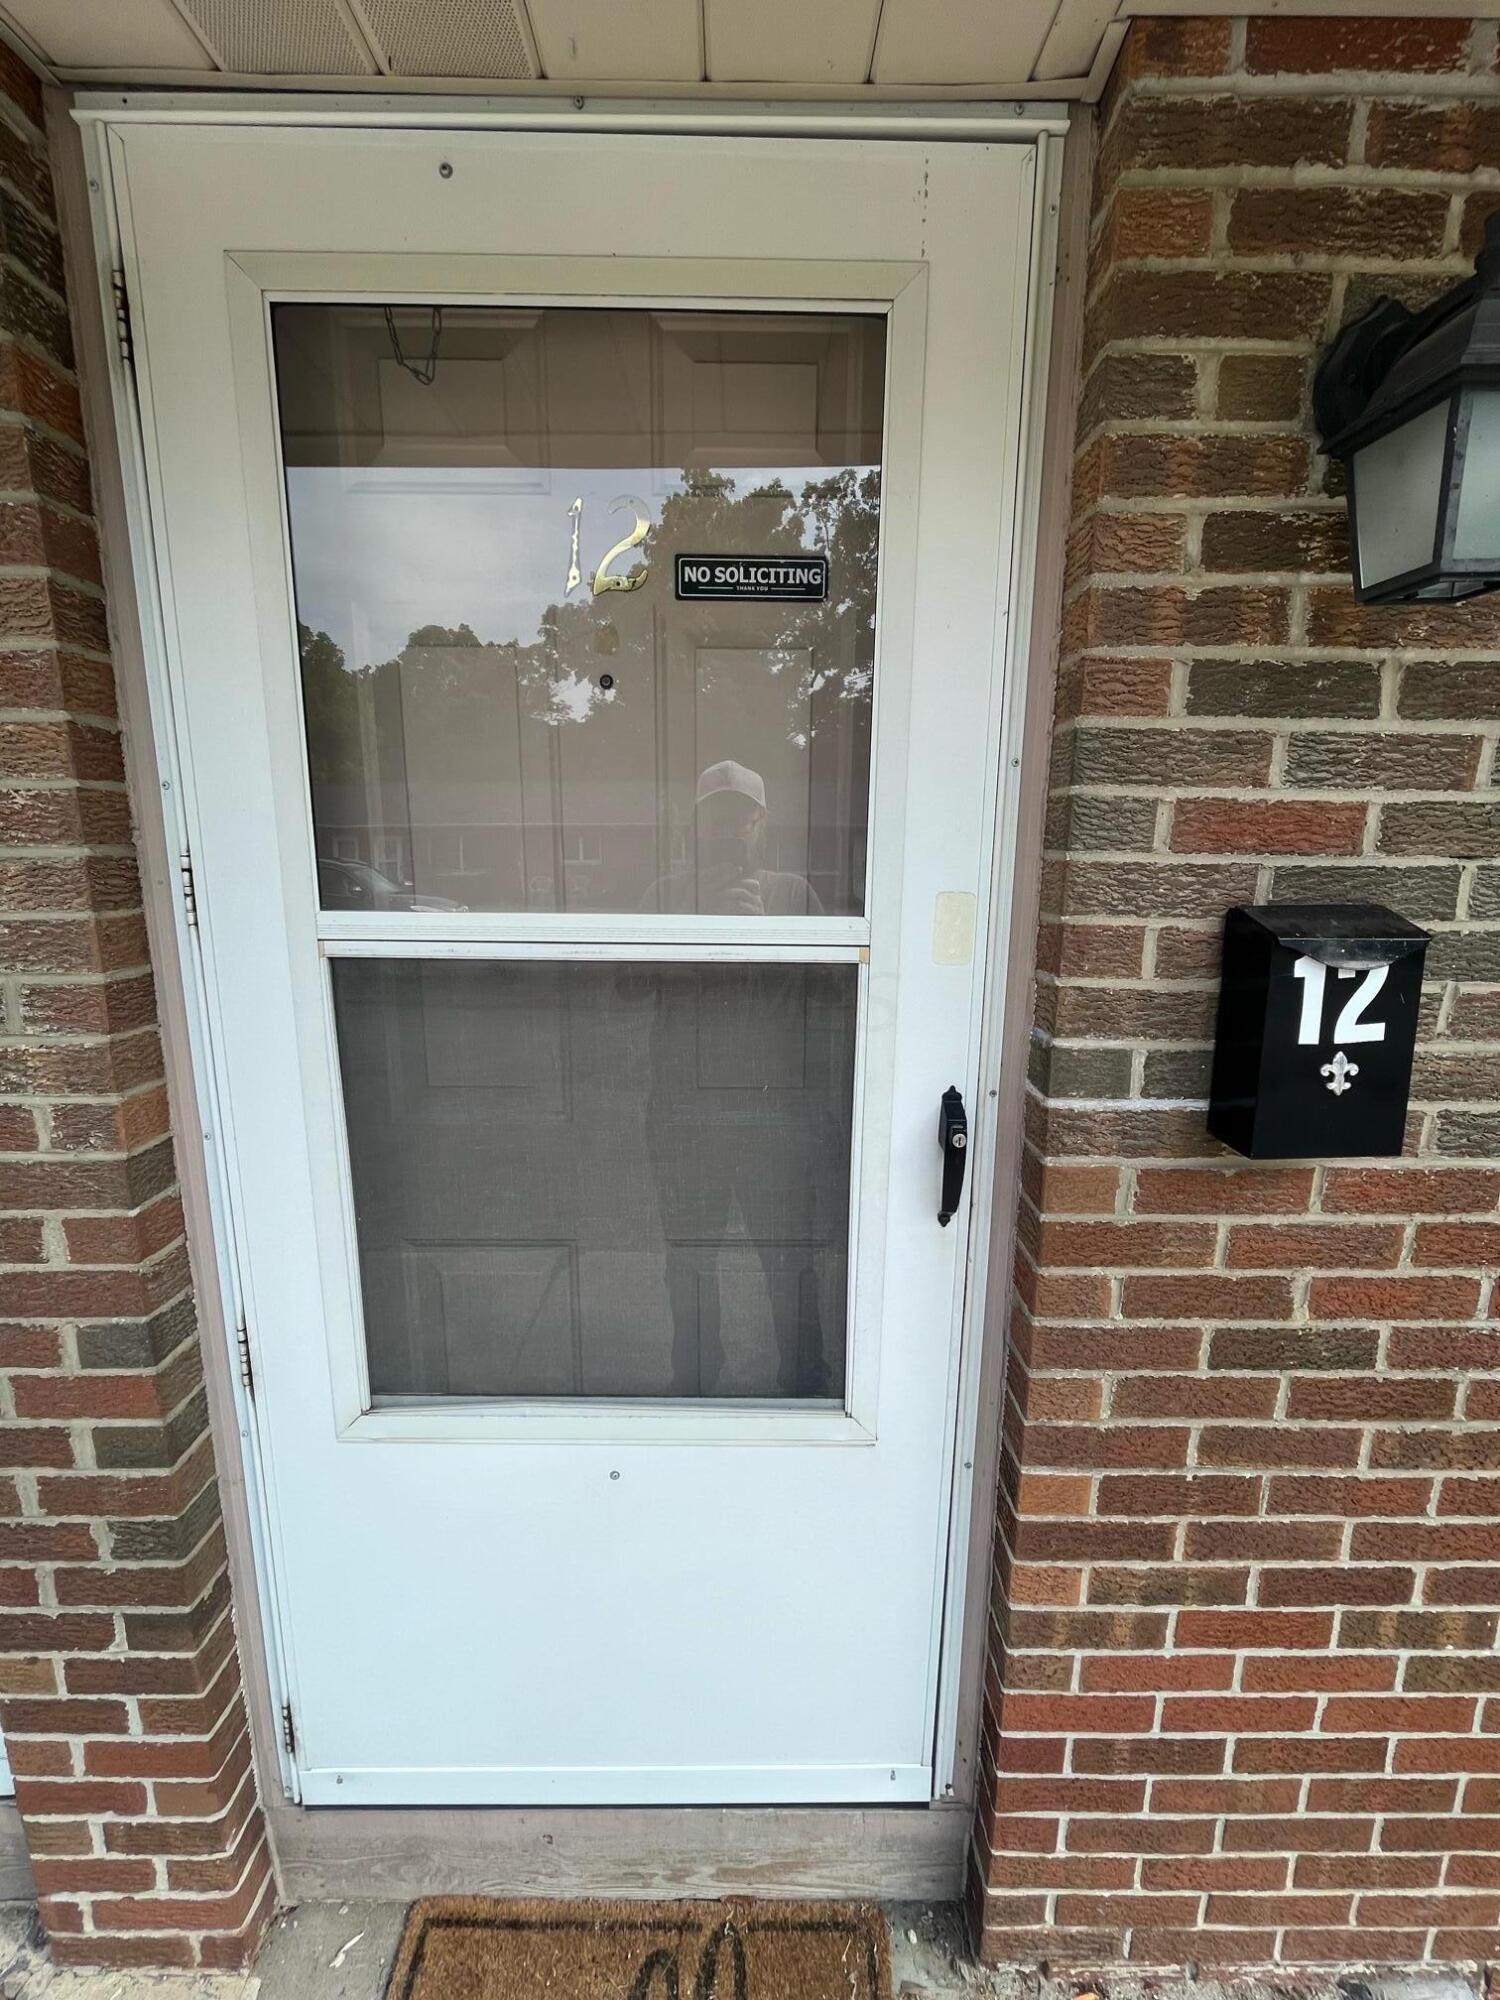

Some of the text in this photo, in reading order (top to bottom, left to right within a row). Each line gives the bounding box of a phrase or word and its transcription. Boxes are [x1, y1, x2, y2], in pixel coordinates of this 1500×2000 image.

[566, 495, 651, 597] 12
[683, 566, 822, 584] NO SOLICITING
[1293, 955, 1390, 1045] 12
